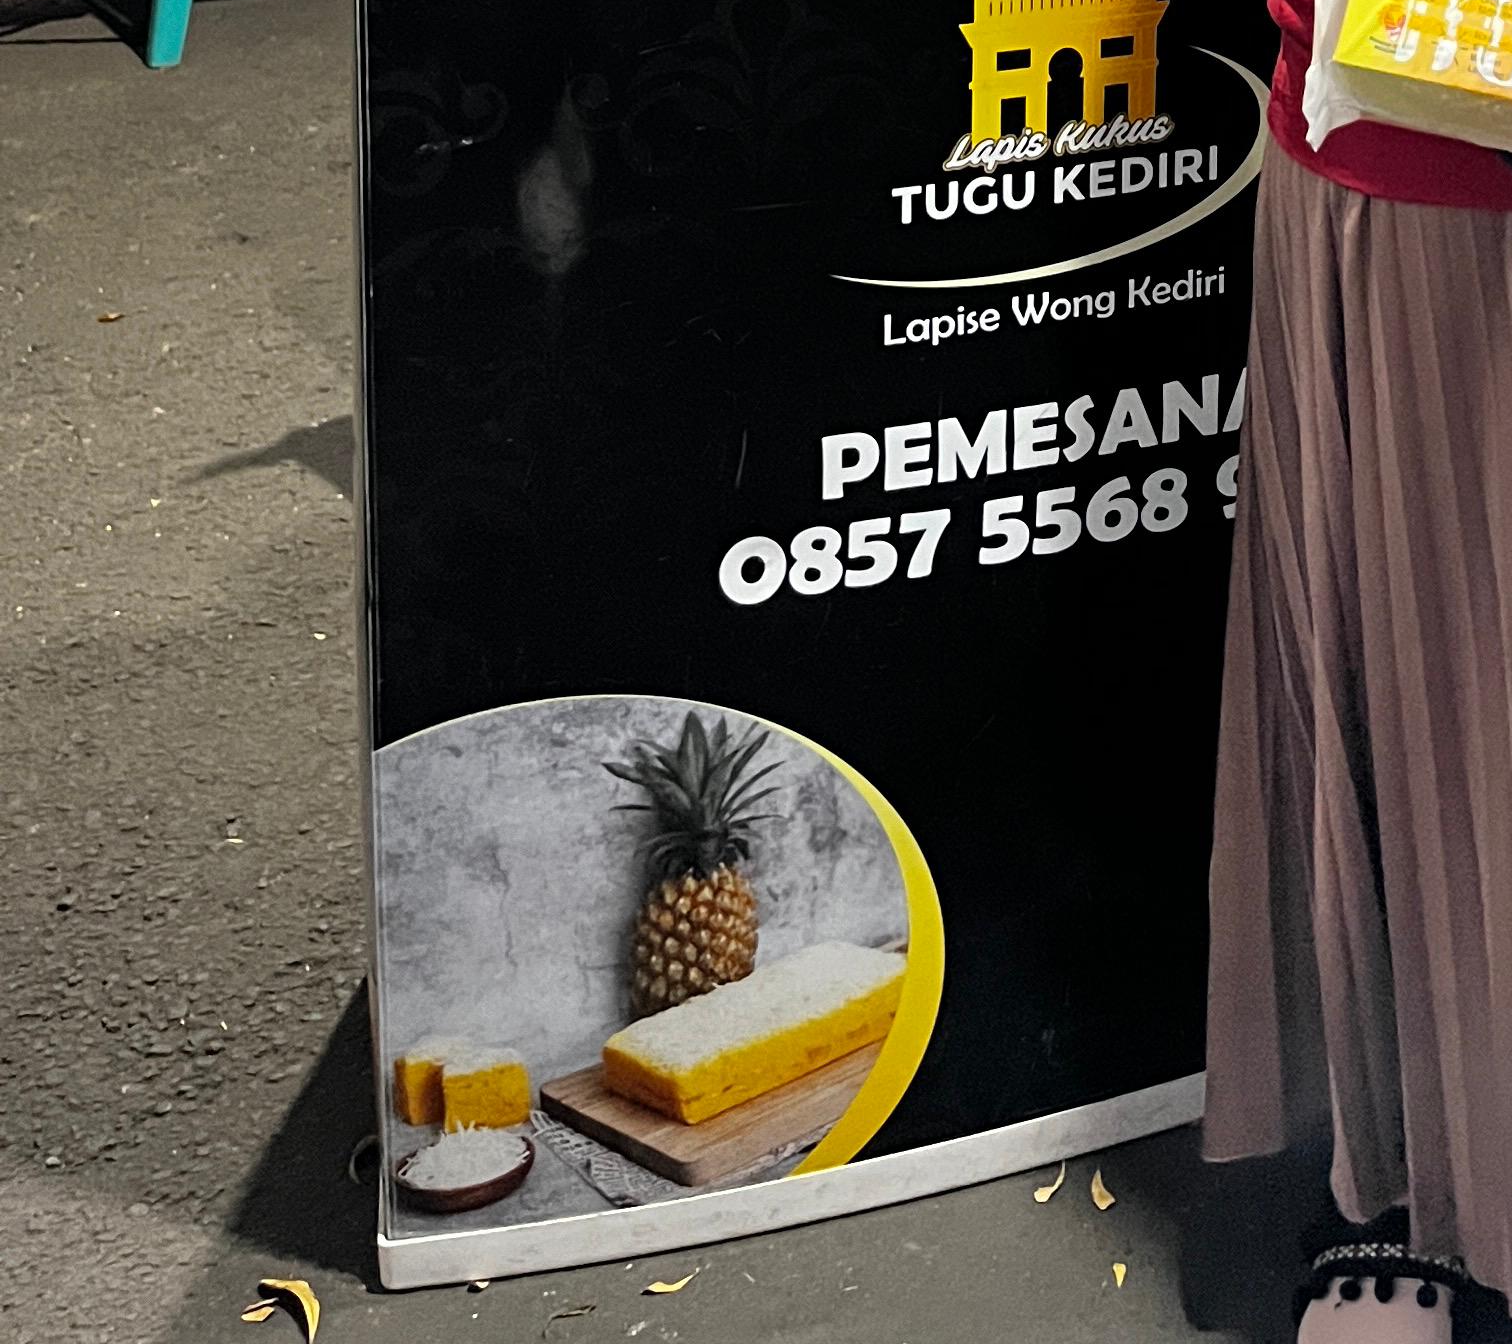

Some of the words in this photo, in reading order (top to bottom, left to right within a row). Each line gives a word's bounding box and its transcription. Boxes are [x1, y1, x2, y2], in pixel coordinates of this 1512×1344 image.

[943, 124, 1050, 173] Lapis
[1056, 112, 1177, 158] Kukus
[891, 171, 1037, 225] TUGU
[1053, 144, 1219, 204] KEDIRI
[883, 305, 1001, 346] Lapise
[1011, 290, 1115, 328] Wong
[1128, 265, 1226, 310] Kediri
[718, 507, 952, 606] 0857
[978, 466, 1189, 567] 5568
